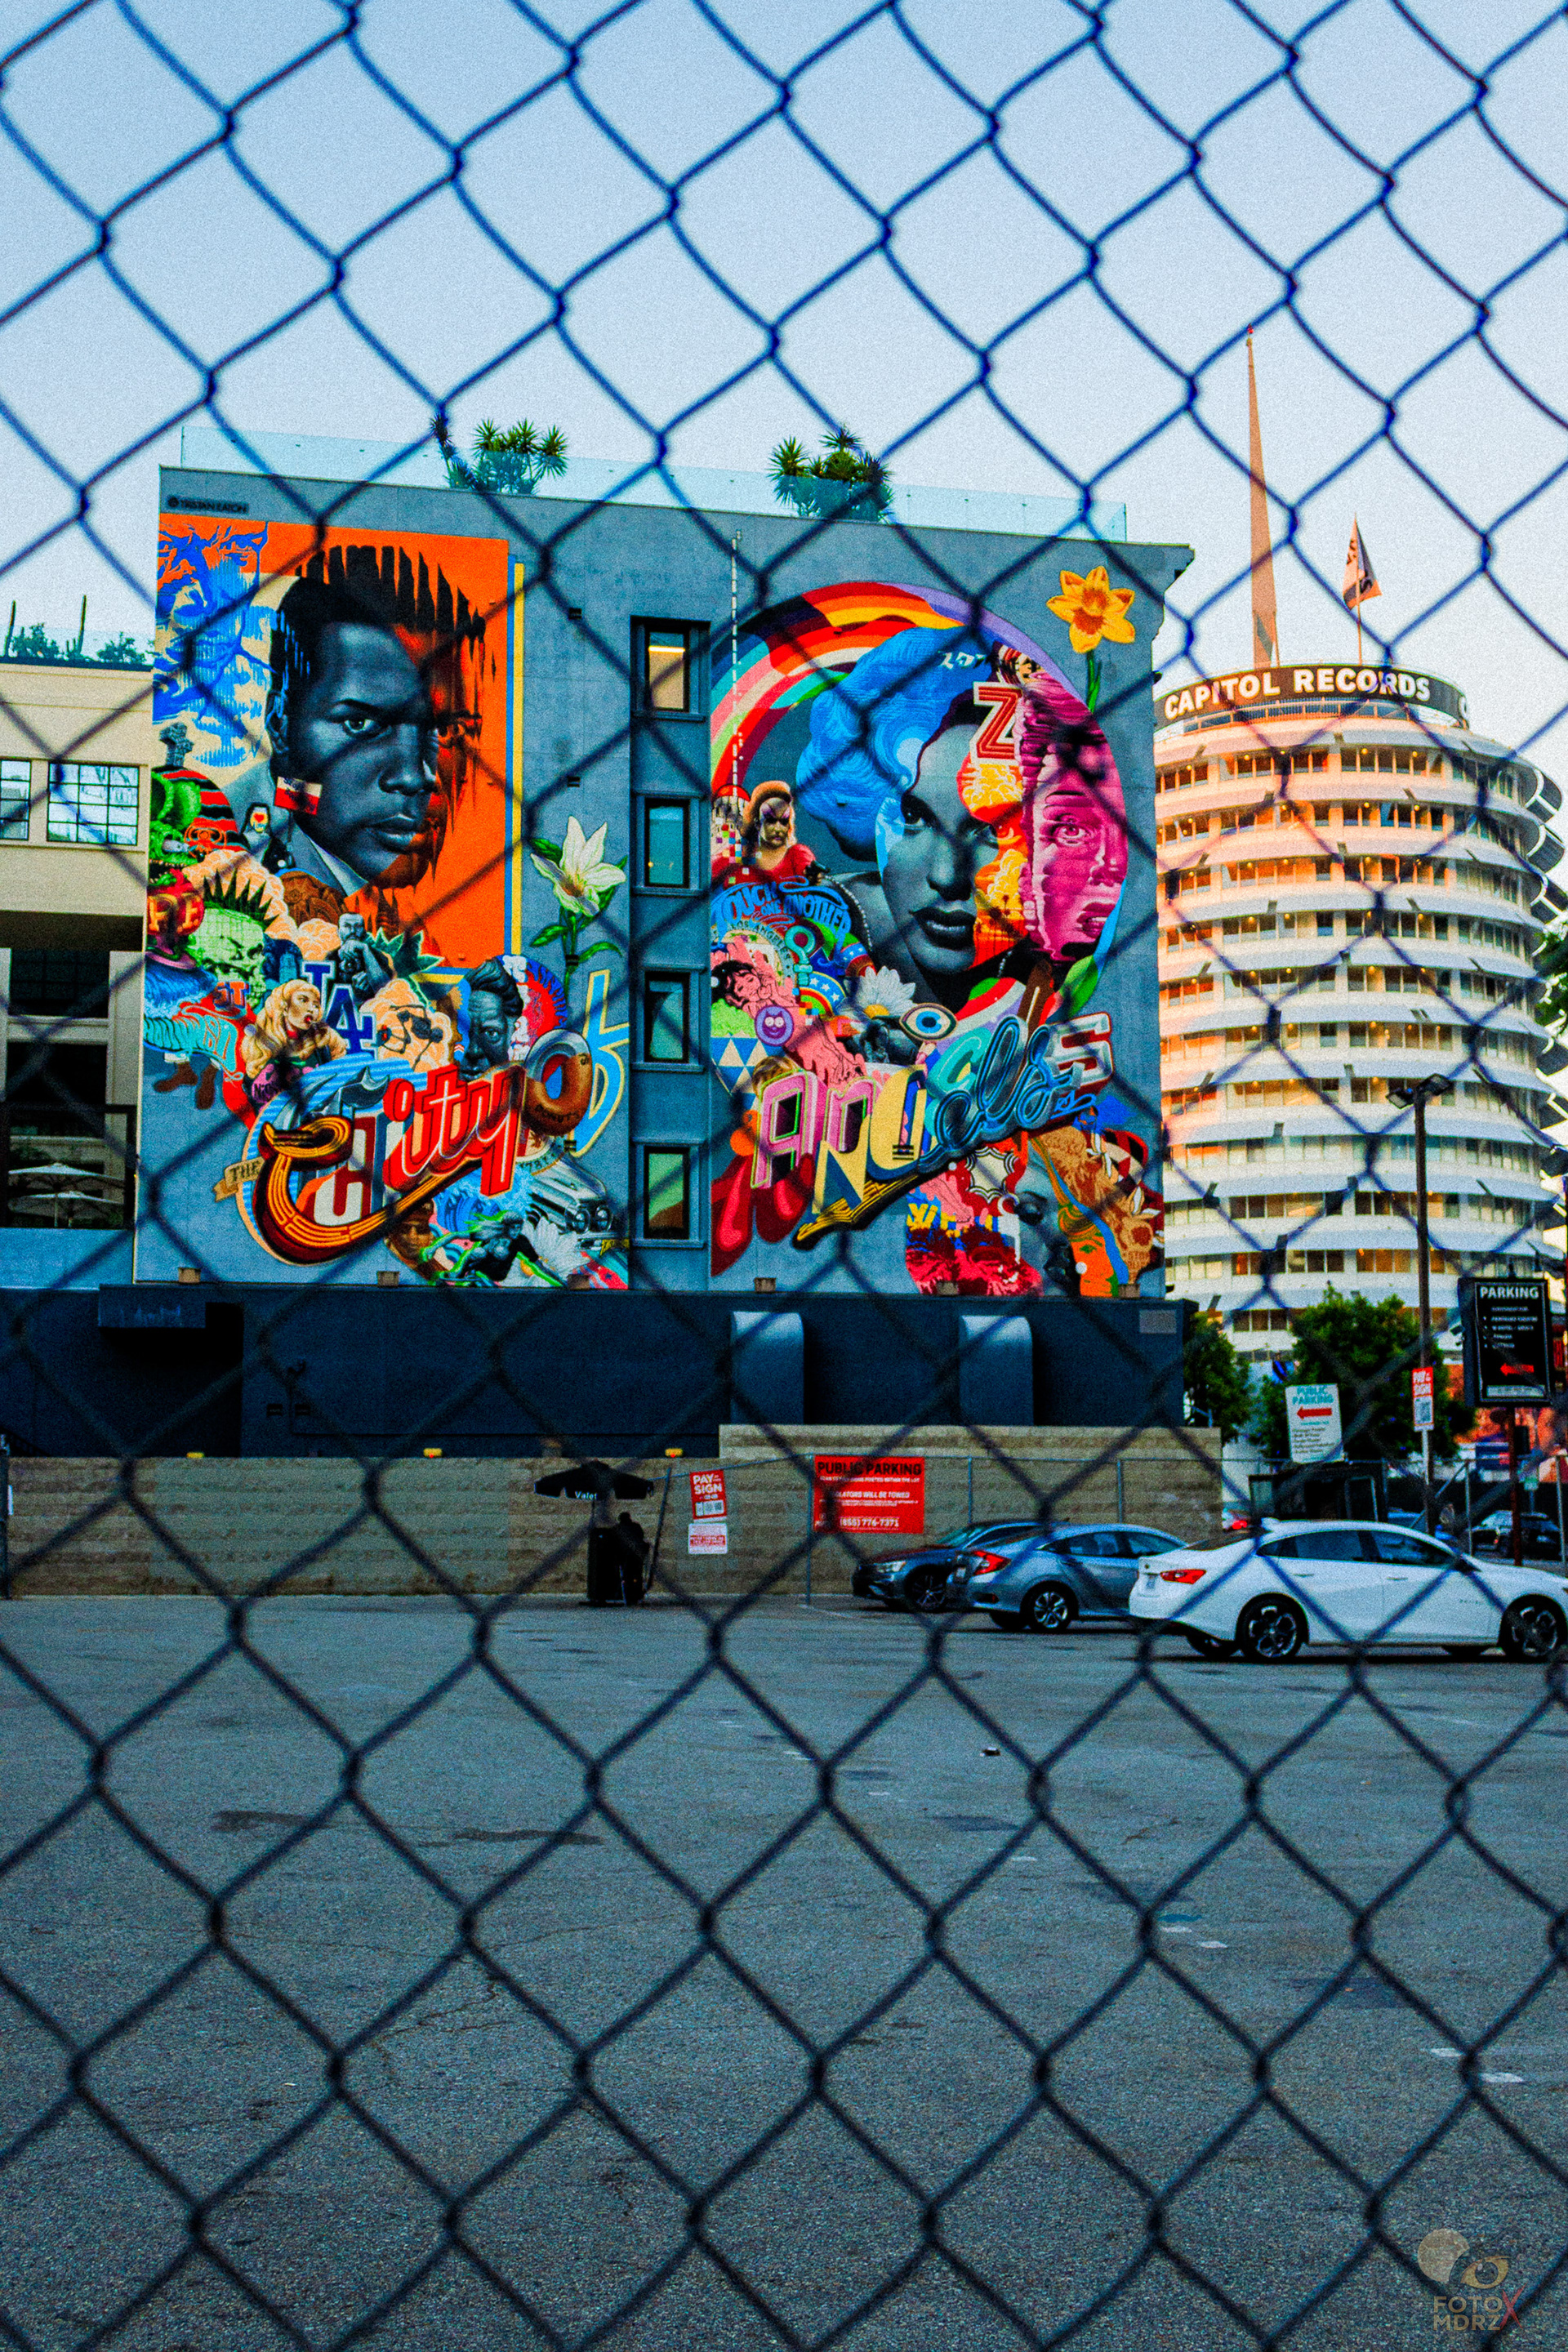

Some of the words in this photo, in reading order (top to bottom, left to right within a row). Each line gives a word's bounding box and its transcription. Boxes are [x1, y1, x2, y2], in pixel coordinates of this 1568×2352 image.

[1165, 673, 1281, 719] CAPITOL
[1294, 668, 1431, 702] RECORDS
[1480, 1286, 1539, 1298] PARKING
[817, 1462, 863, 1474] PUBLIC
[866, 1463, 922, 1476] PARKING
[693, 1473, 714, 1485] PAY
[694, 1483, 723, 1494] SIGN
[575, 1490, 597, 1500] Valet
